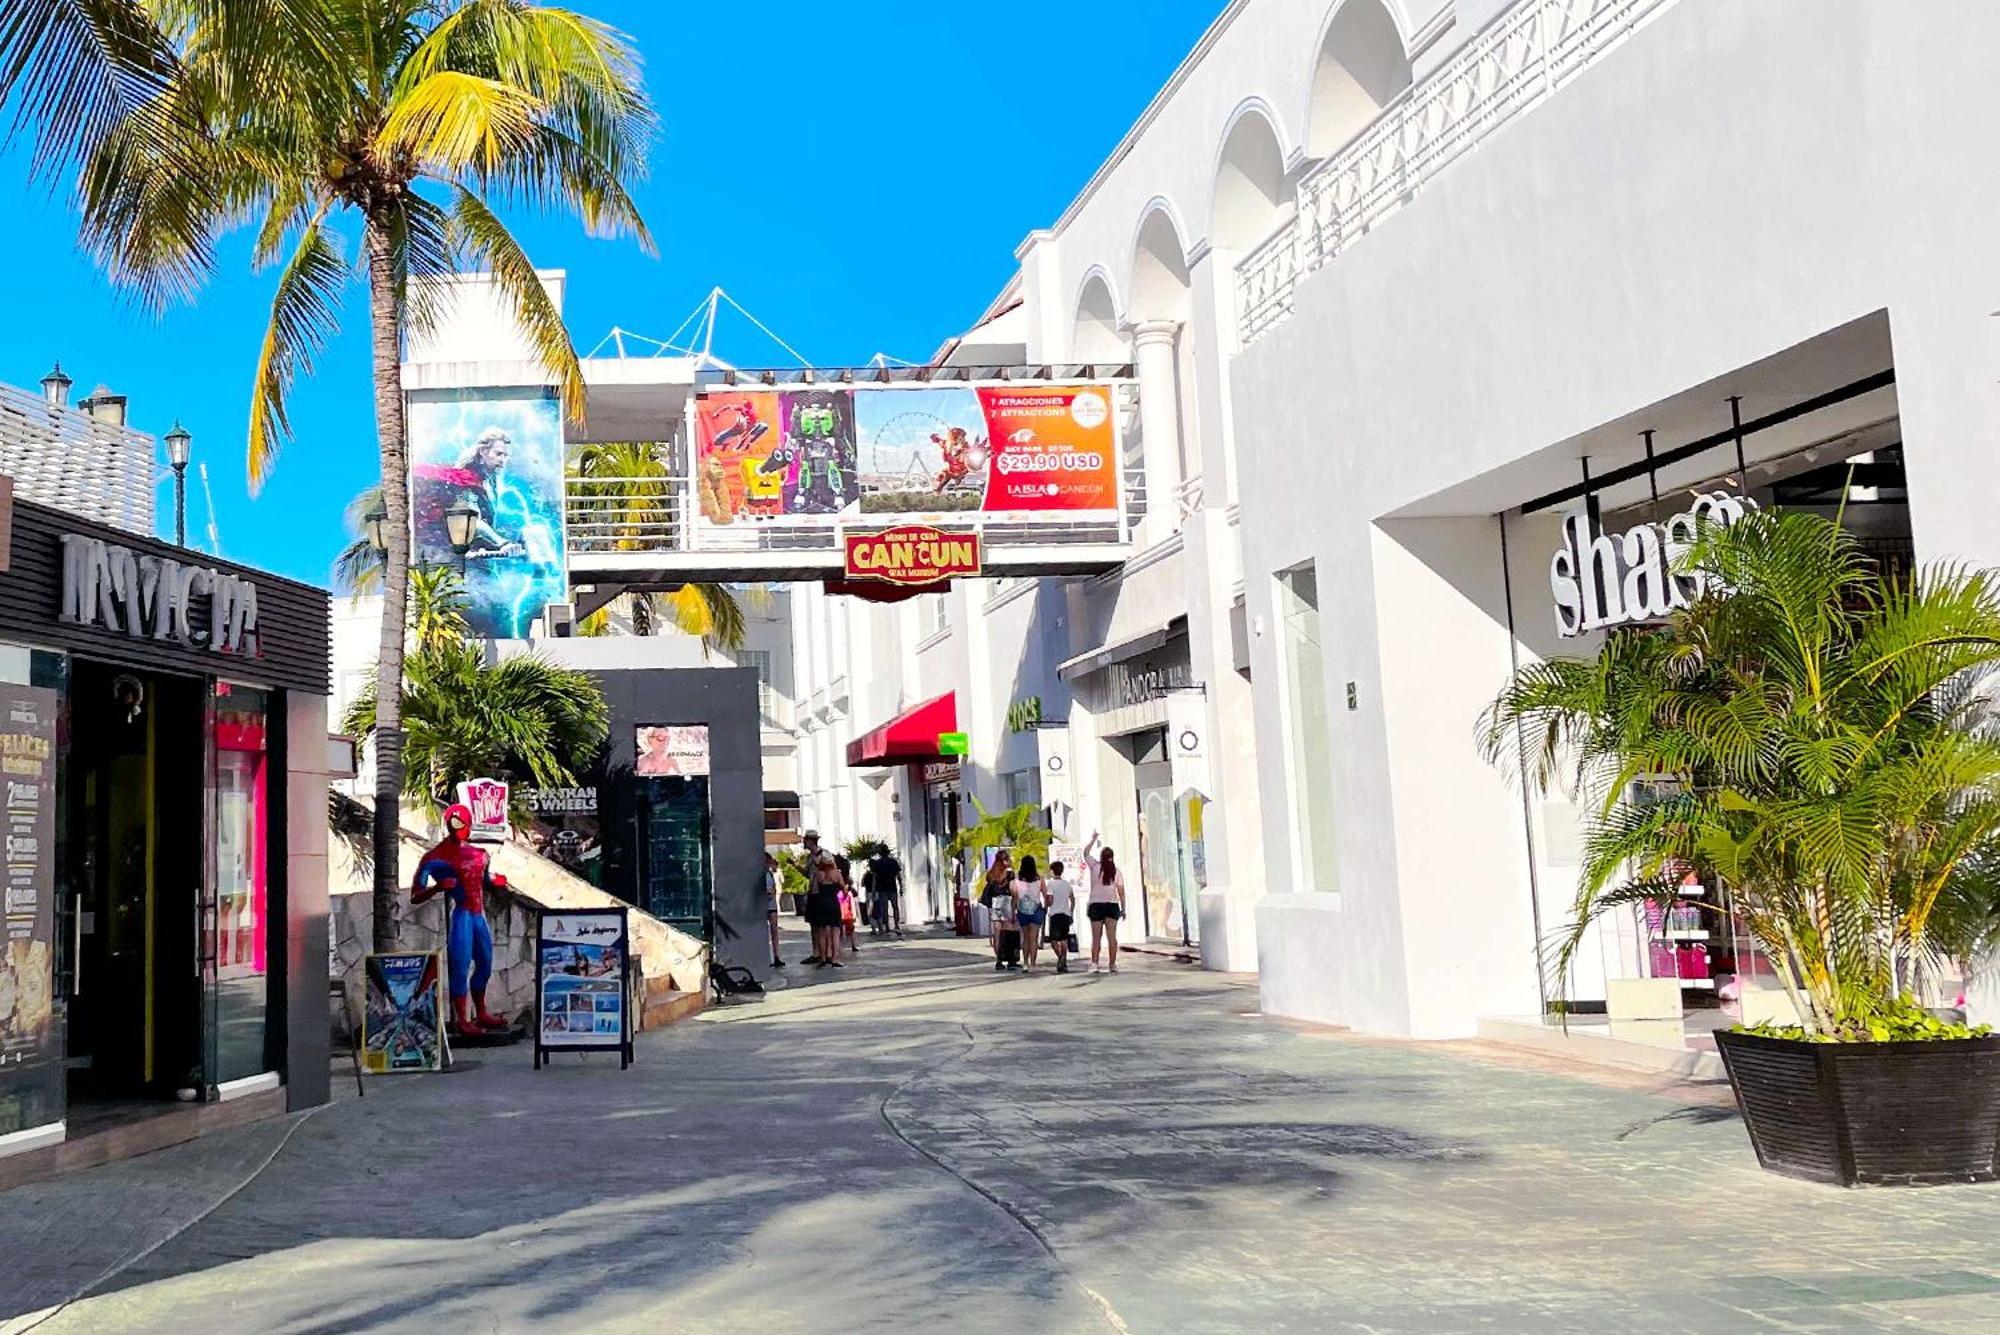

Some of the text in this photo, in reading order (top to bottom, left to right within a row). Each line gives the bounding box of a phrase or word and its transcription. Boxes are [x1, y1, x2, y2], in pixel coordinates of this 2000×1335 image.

[1001, 409, 1067, 417] ATTRACTIONS
[999, 454, 1102, 472] $29.90 USD
[58, 534, 264, 659] INVICTA
[557, 786, 597, 799] THAN
[541, 798, 598, 811] WHEELS
